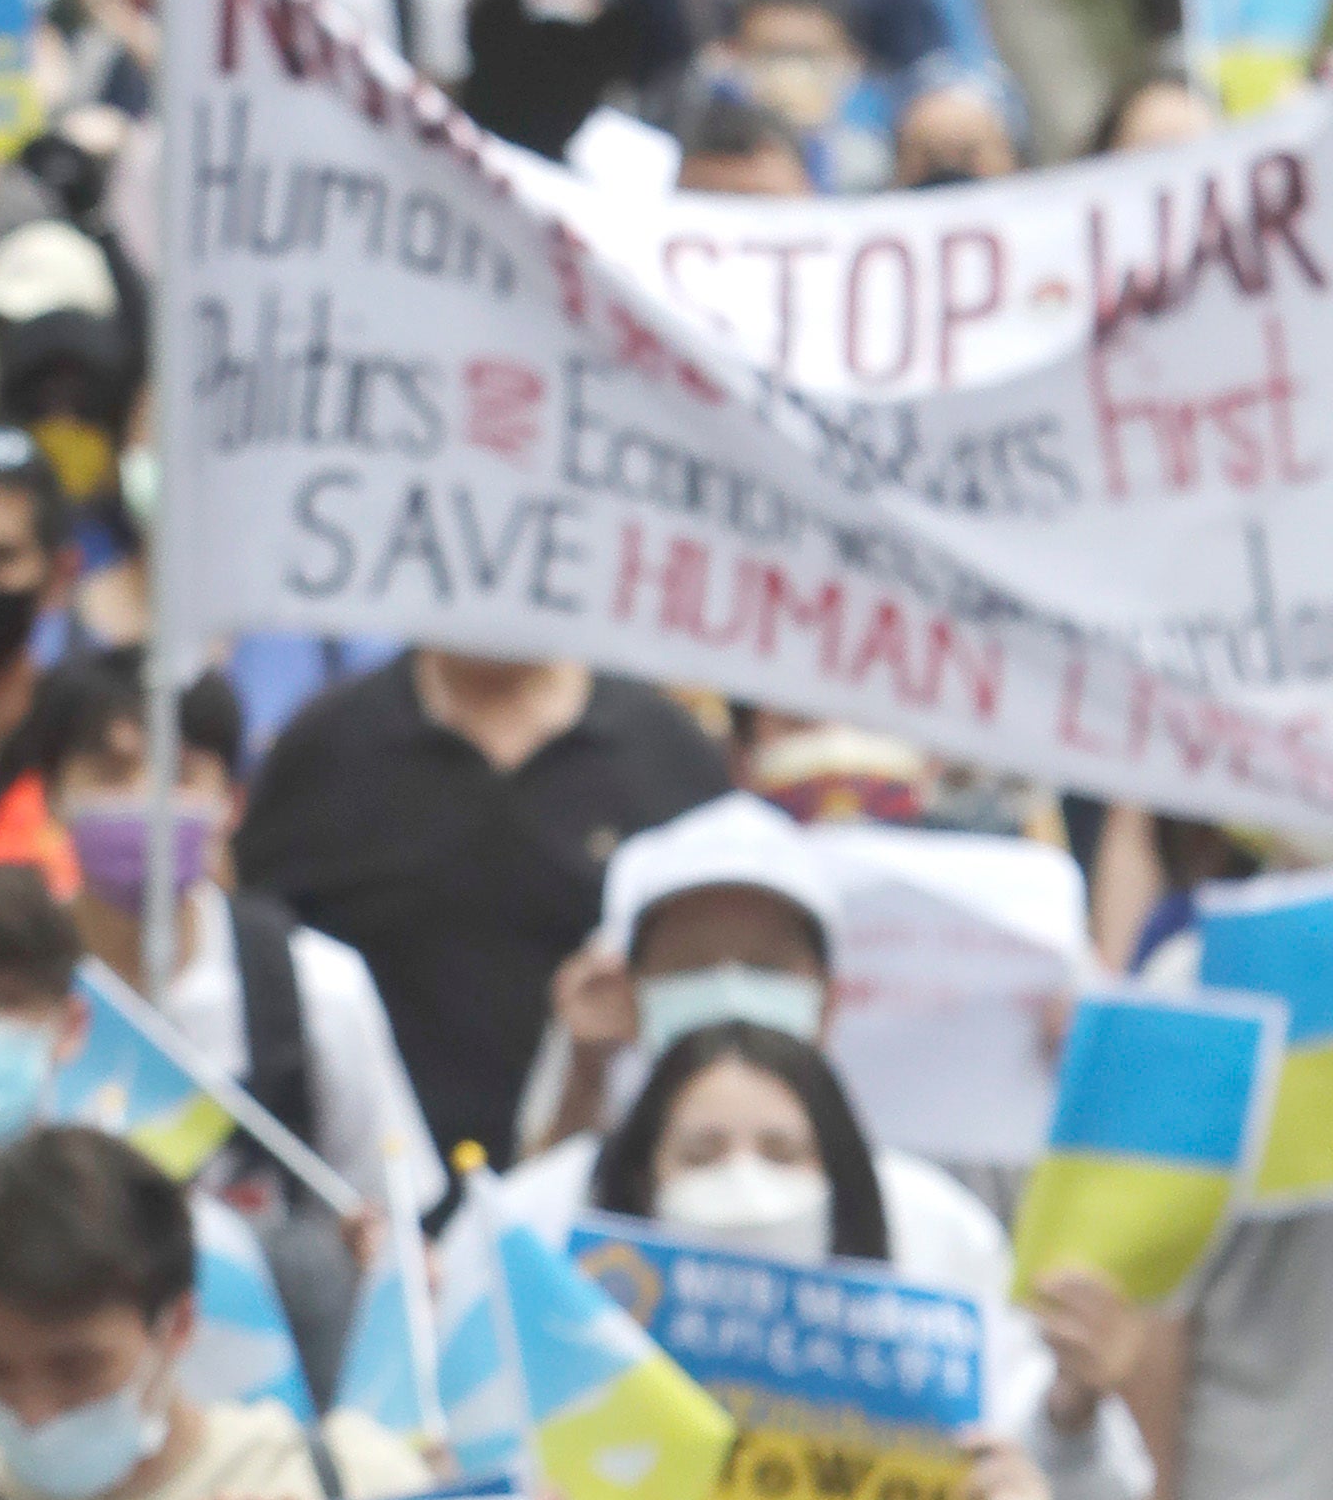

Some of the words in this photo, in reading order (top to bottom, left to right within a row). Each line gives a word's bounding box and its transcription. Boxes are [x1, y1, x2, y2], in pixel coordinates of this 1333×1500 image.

[663, 228, 1005, 389] STOP
[1088, 148, 1325, 348] WAR
[283, 465, 586, 613] SAVE
[610, 518, 1003, 723] HUMAN
